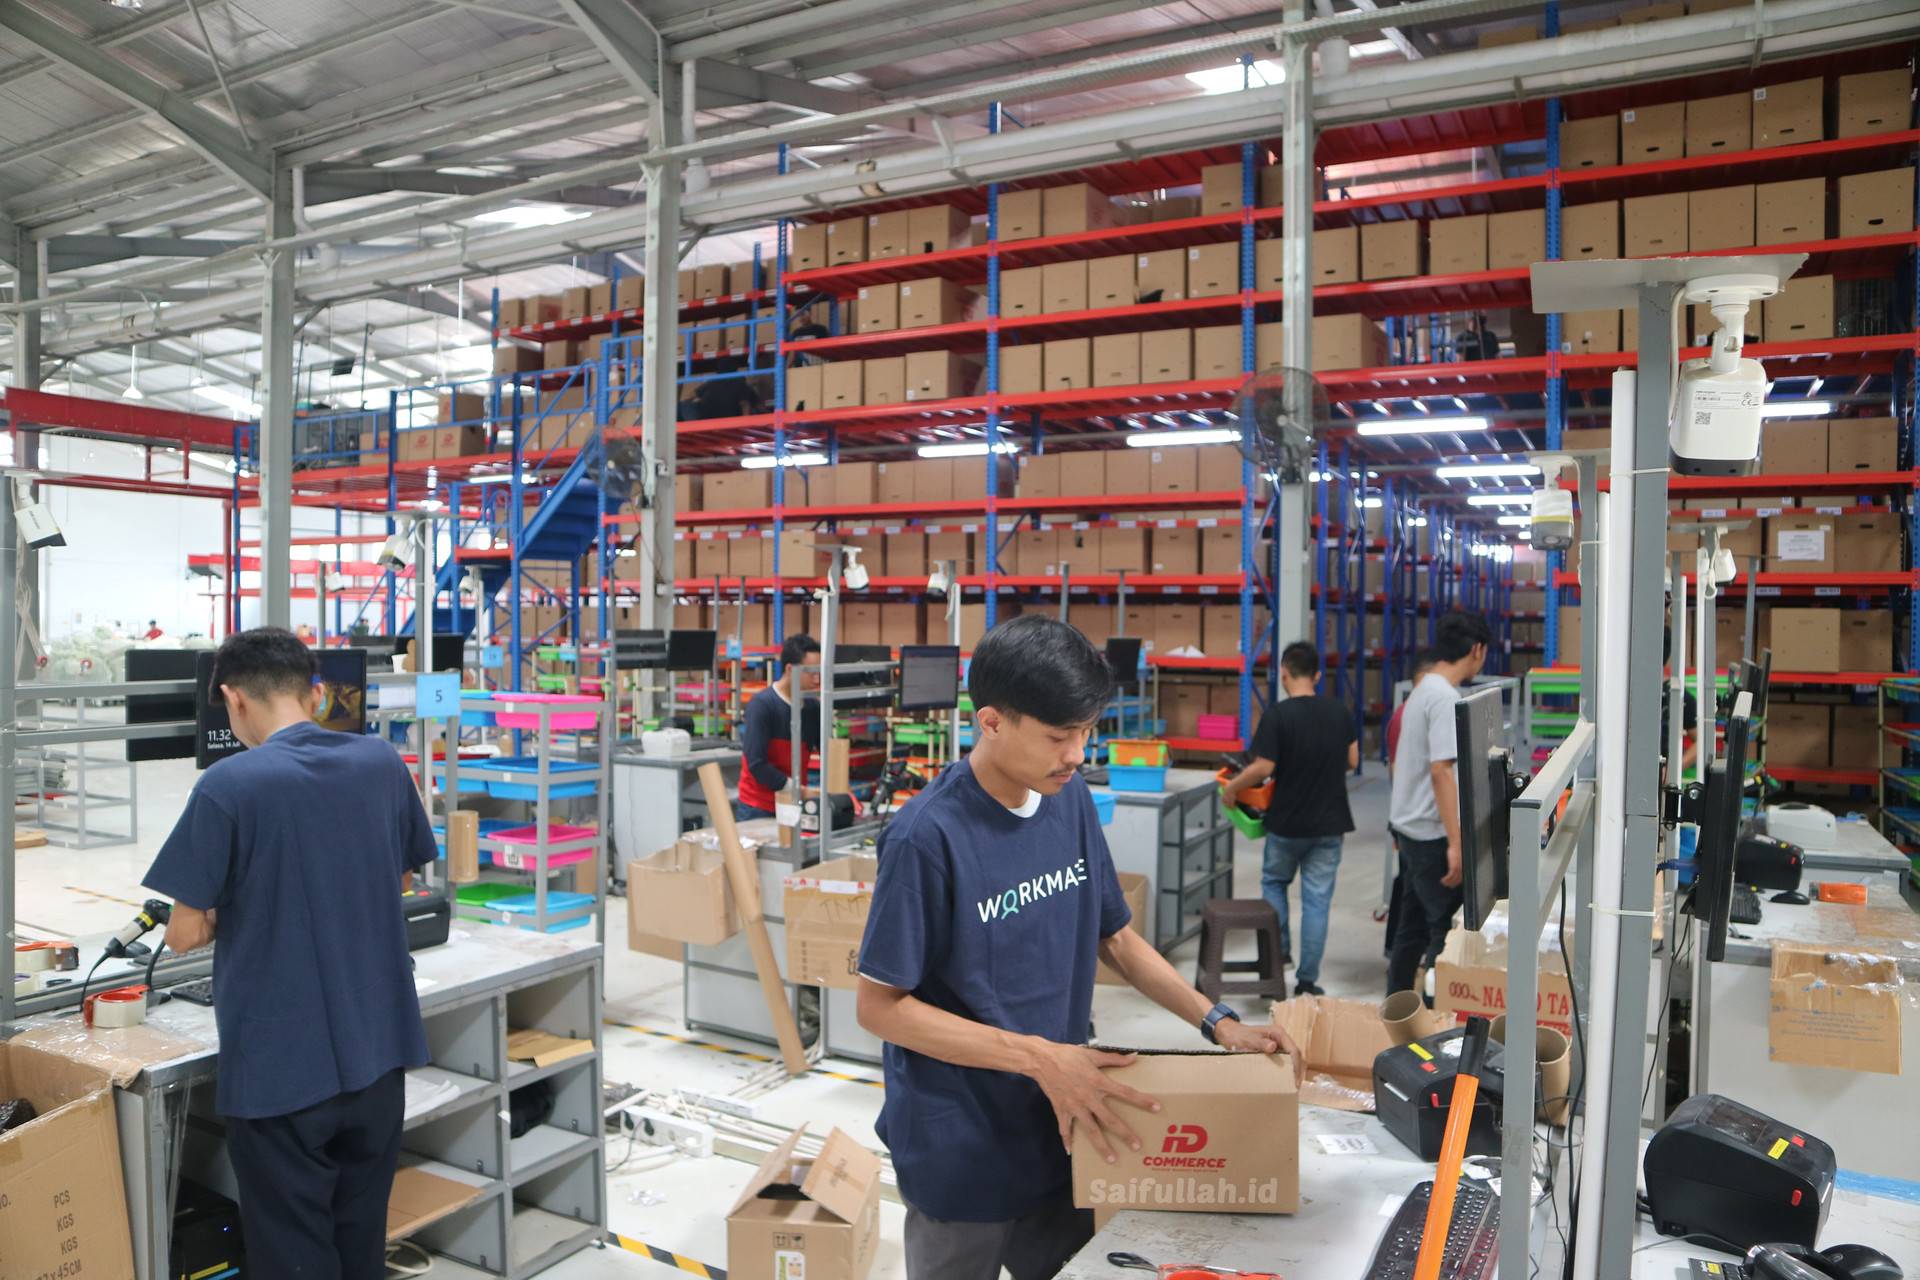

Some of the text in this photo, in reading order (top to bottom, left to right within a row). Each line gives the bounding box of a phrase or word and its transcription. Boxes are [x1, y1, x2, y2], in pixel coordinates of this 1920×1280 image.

[435, 689, 443, 703] 5
[207, 729, 231, 741] 11.32
[1143, 1156, 1227, 1169] COMMERCE
[53, 1189, 71, 1208] PCS
[56, 1213, 74, 1232] KGS
[60, 1236, 79, 1255] KGS
